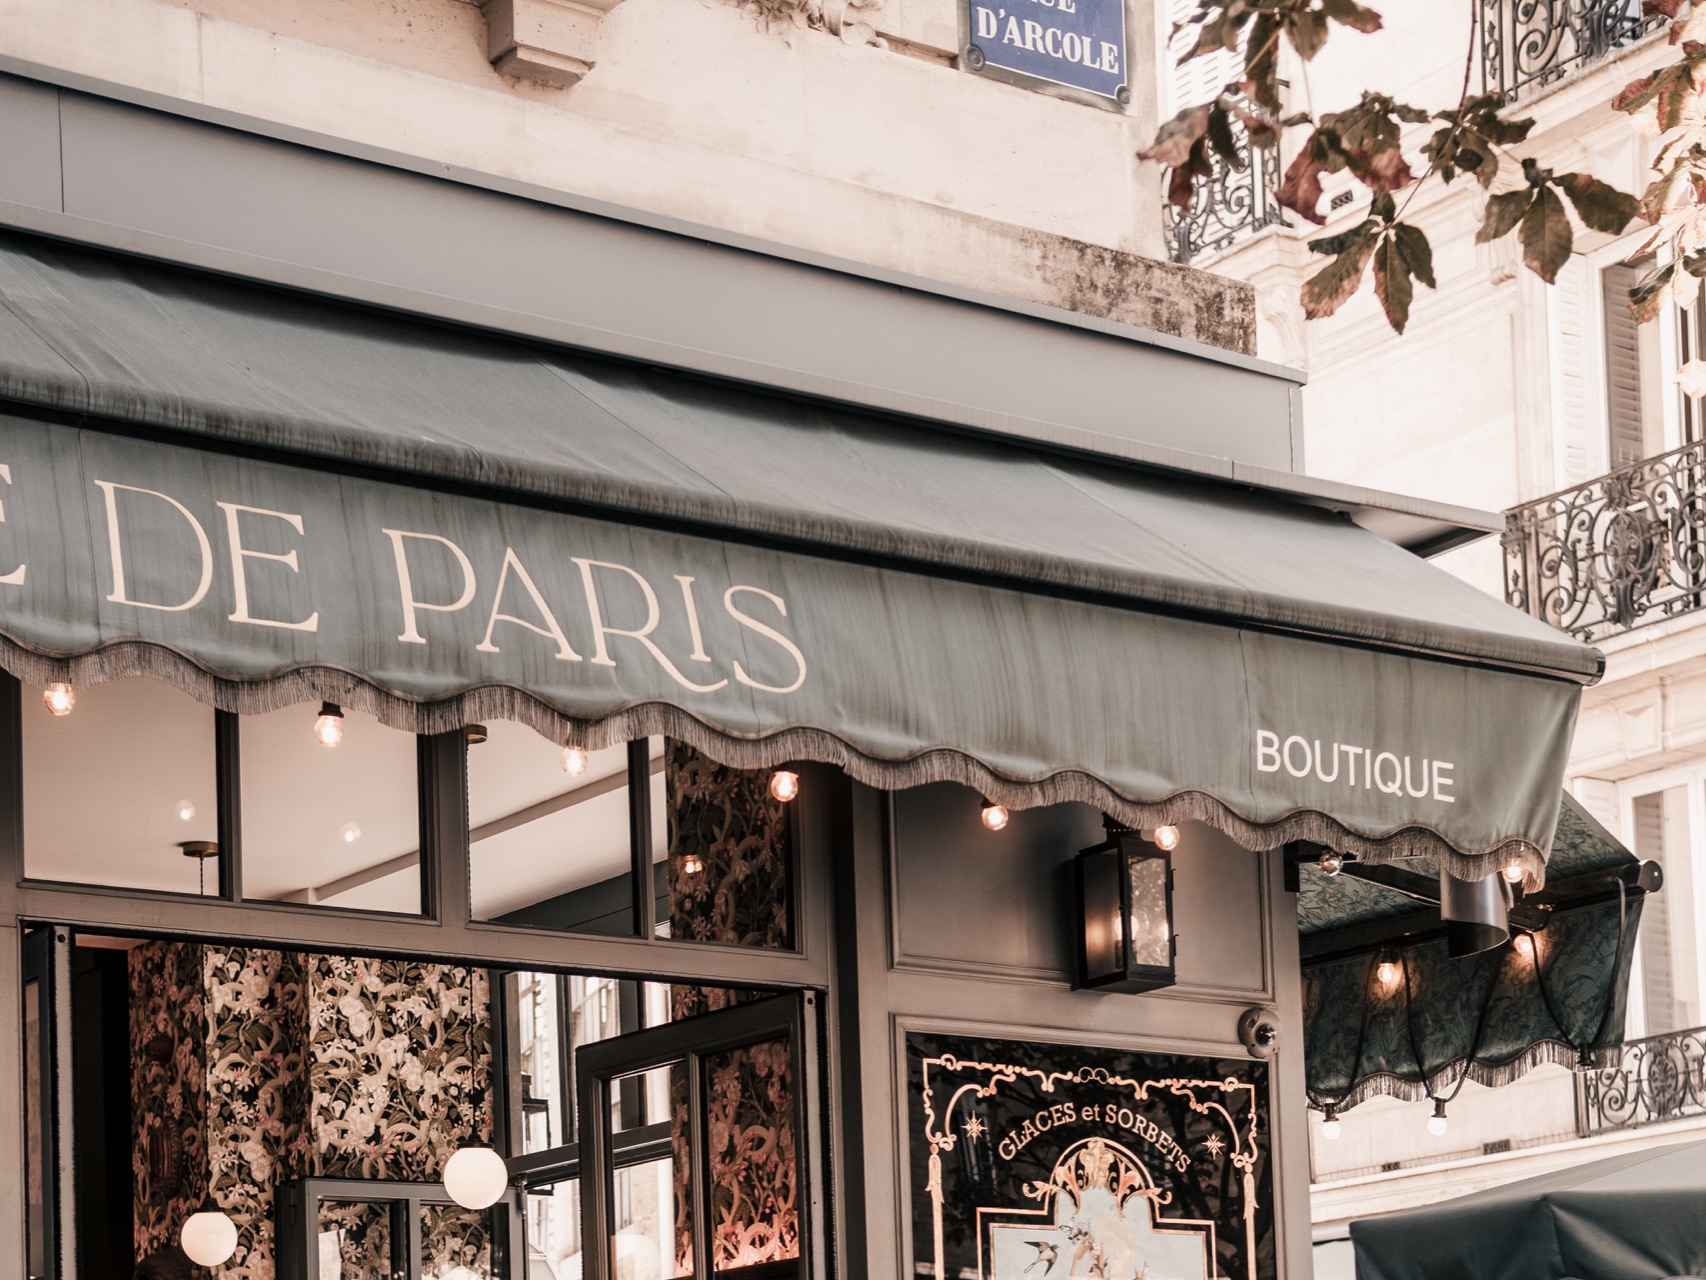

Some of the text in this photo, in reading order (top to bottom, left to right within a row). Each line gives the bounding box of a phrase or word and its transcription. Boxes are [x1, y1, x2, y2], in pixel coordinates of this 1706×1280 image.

[976, 6, 1119, 75] D'ARCOLE
[94, 479, 319, 633] DE
[381, 528, 808, 694] PARIS
[1256, 729, 1456, 803] BOUTIQUE
[998, 1102, 1192, 1174] GLACES et SORBETS
